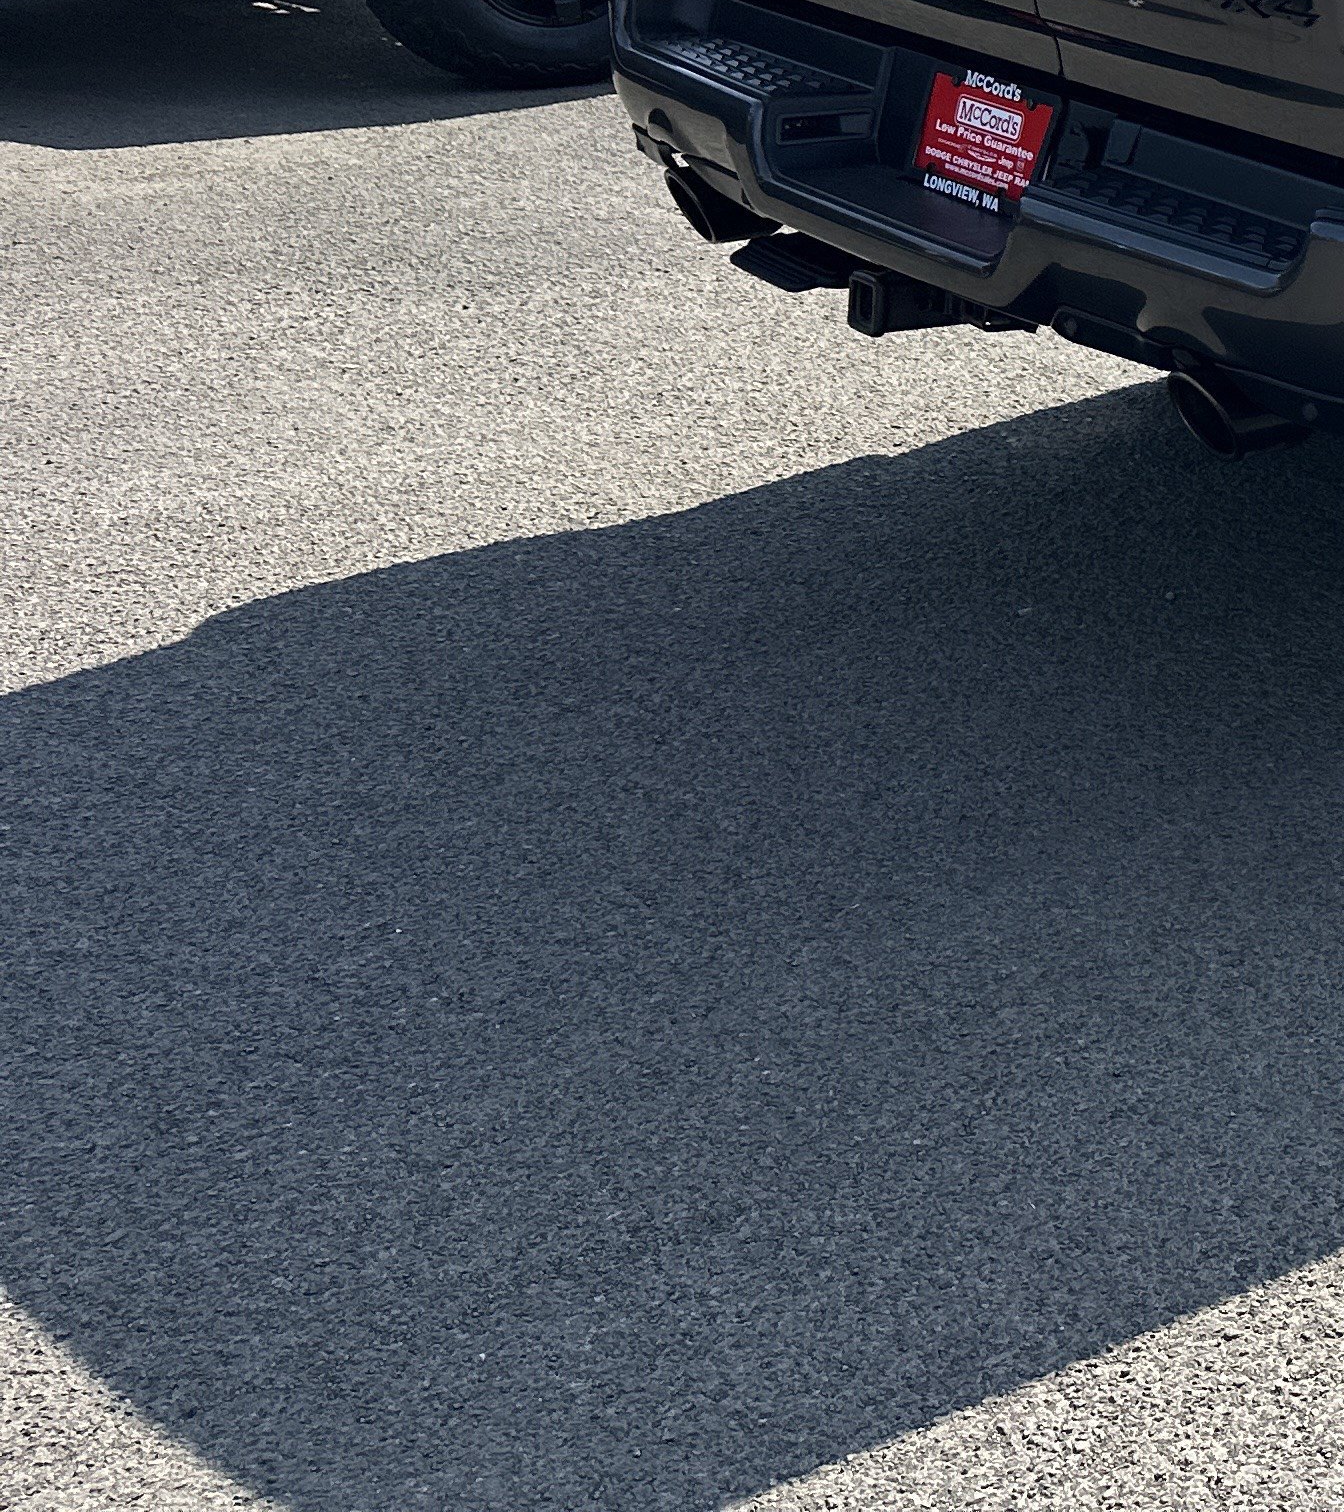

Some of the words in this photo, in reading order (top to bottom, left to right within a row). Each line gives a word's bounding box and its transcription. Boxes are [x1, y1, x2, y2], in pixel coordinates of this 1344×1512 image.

[964, 69, 1022, 102] McCord's
[959, 100, 1019, 136] McCord's
[935, 118, 956, 135] Low
[956, 124, 982, 144] Price
[983, 135, 1034, 161] Guarantee
[925, 145, 952, 163] DODGE
[952, 153, 993, 175] CHRYSLER
[993, 170, 1014, 183] JEEP
[923, 173, 980, 207] LONGVIEW,
[981, 192, 999, 212] WA
